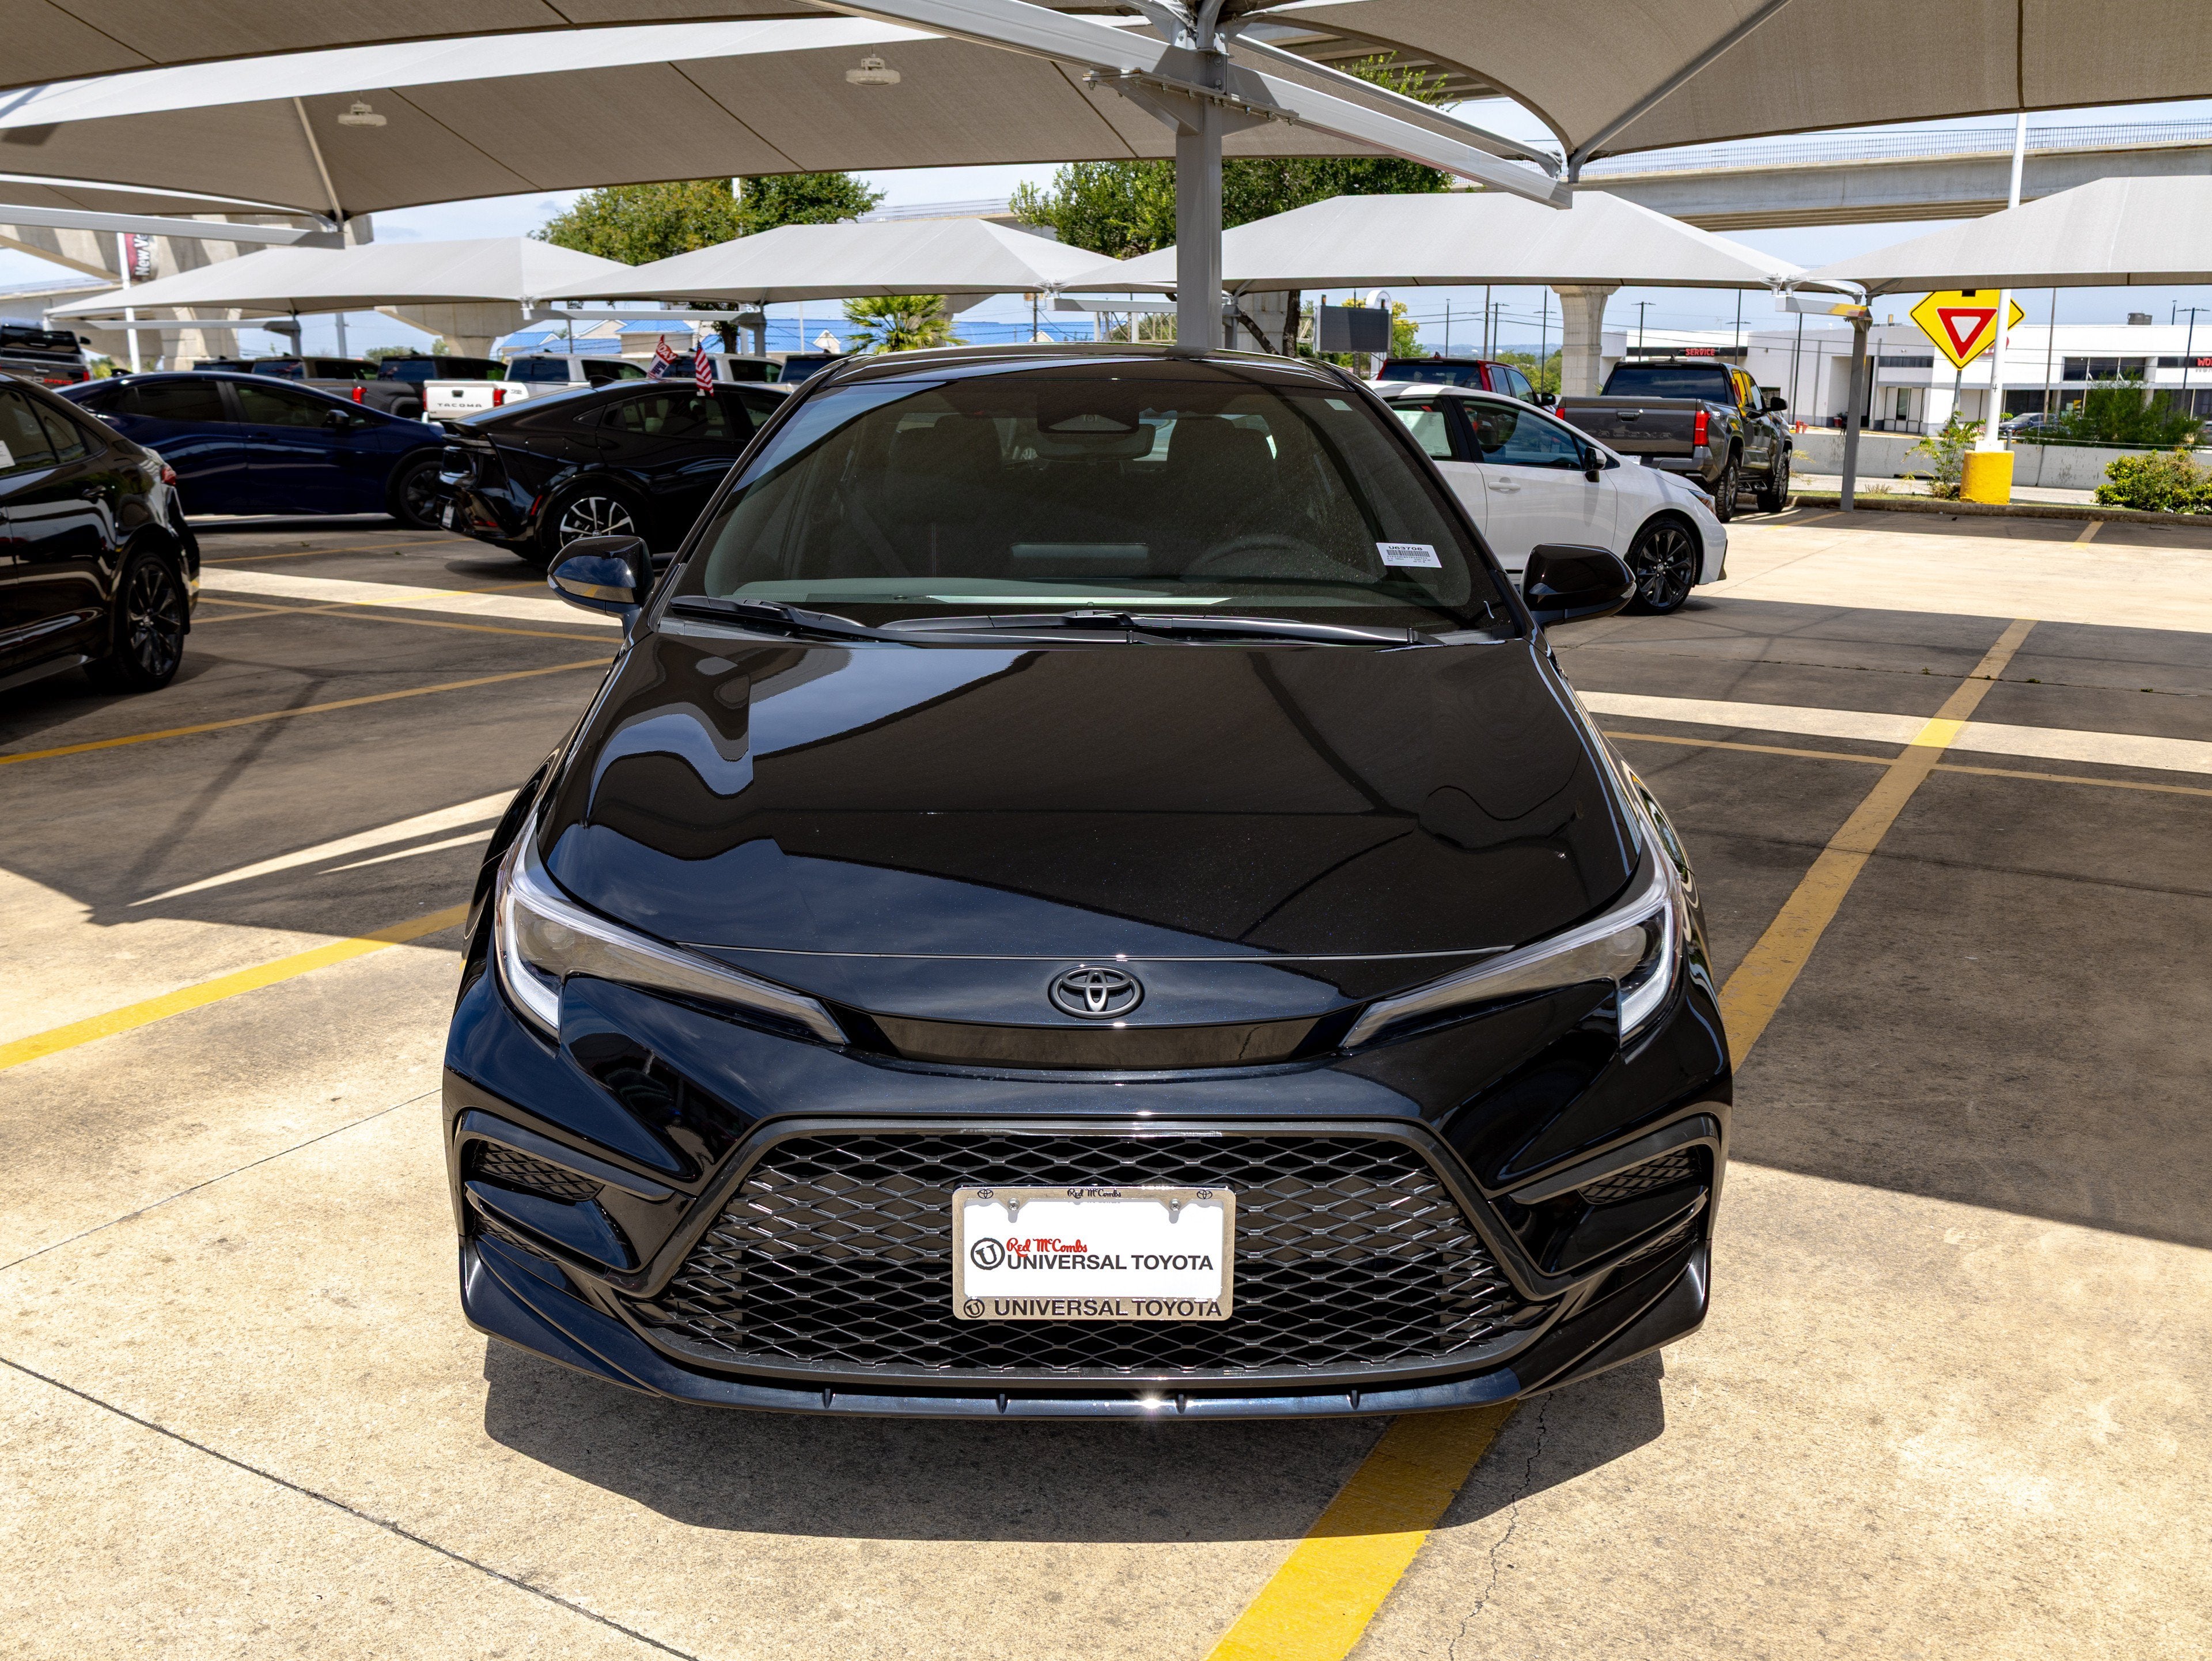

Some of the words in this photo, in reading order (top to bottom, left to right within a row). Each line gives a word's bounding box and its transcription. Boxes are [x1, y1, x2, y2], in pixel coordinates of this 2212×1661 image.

[134, 248, 150, 276] New
[2197, 357, 2212, 366] WO
[1067, 1188, 1084, 1199] Red
[1085, 1187, 1122, 1197] McCombs
[1006, 1238, 1031, 1257] Red
[1033, 1238, 1087, 1253] McCombs
[1007, 1255, 1127, 1270] UNIVERSAL
[1131, 1255, 1214, 1270] TOYOTA
[994, 1298, 1128, 1316] UNIVERSAL
[1131, 1298, 1222, 1316] TOYOTA
